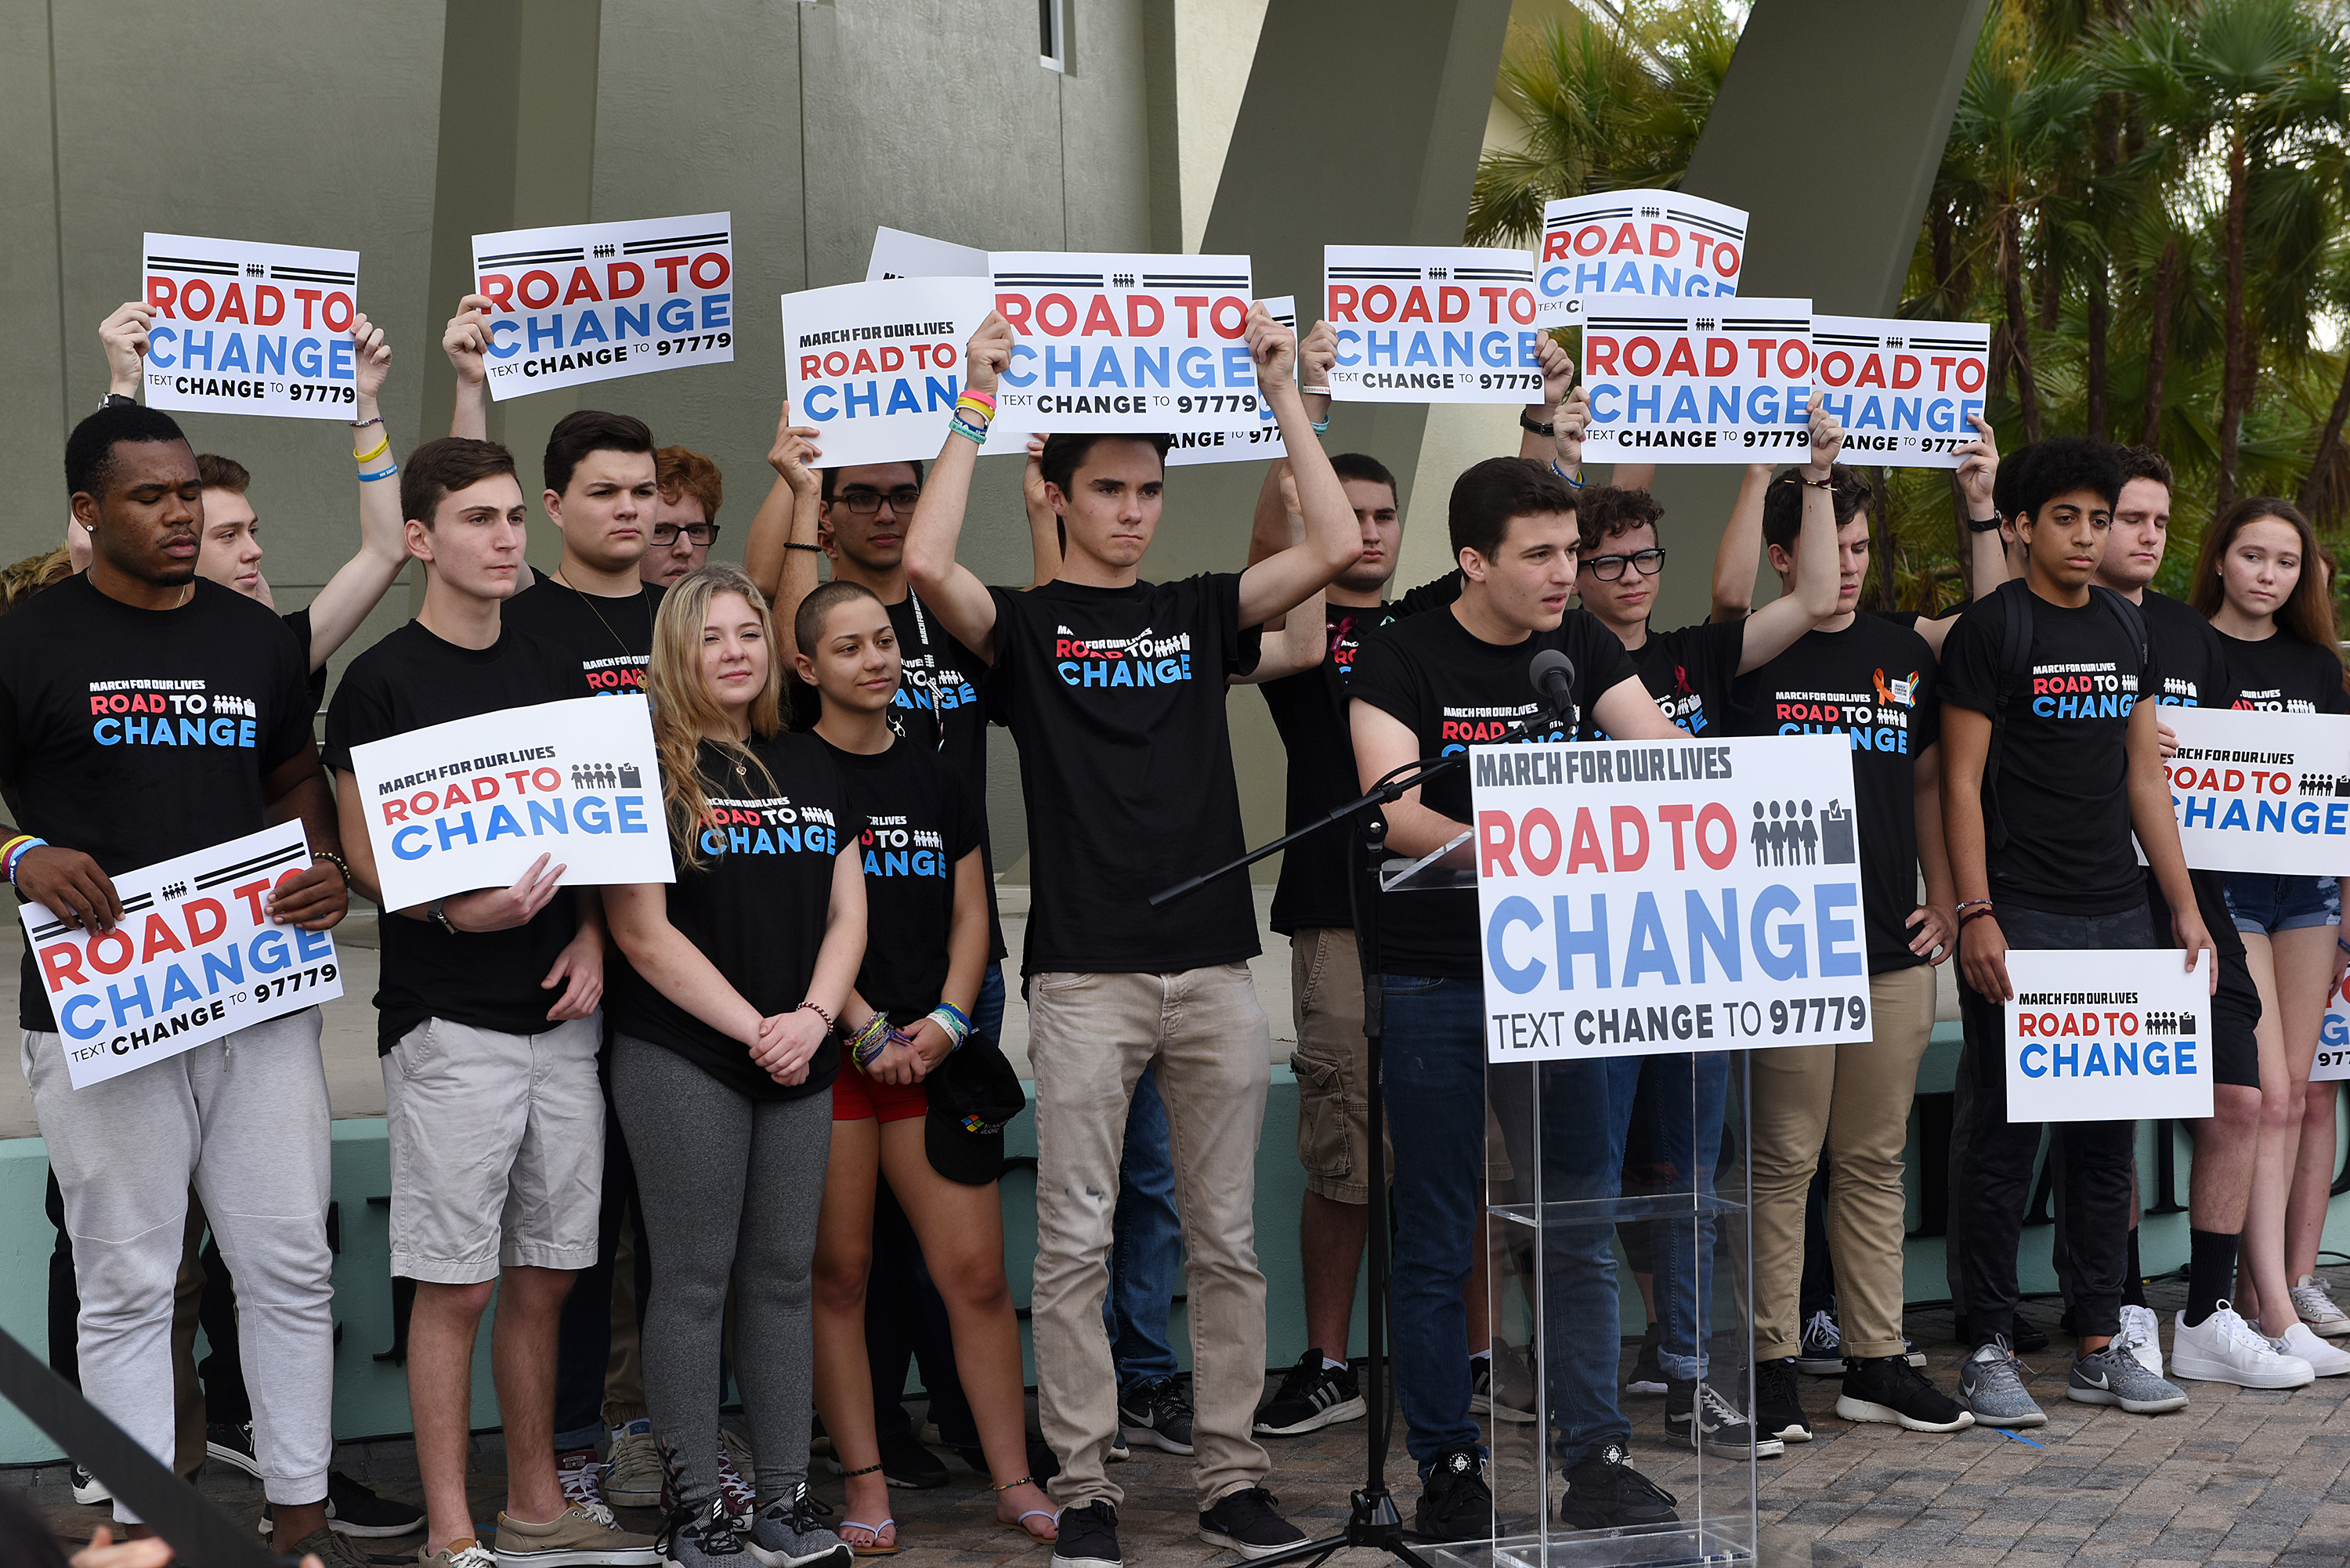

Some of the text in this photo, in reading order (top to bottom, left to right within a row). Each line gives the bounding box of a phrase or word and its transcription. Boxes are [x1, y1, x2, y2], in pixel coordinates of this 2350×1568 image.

[1542, 222, 1740, 277] ROAD TO
[479, 252, 730, 315] ROAD TO
[147, 276, 354, 333] ROAD TO
[996, 293, 1249, 340] ROAD TO
[1329, 284, 1536, 325] ROAD TO
[1538, 301, 1563, 312] TEXT
[486, 293, 730, 359] CHANGE
[800, 321, 954, 348] MARCH FOR OUR LIVES
[147, 327, 354, 380] CHANGE
[490, 332, 731, 378] TEXT CHANGE TO 97779
[801, 342, 957, 381] ROAD TO
[1335, 330, 1541, 367] CHANGE
[1586, 336, 1810, 379] ROAD TO
[1002, 344, 1255, 388] CHANGE
[1332, 372, 1542, 389] TEXT CHANGE TO 97779
[1930, 356, 1986, 393] TO
[148, 374, 356, 403] TEXT CHANGE TO 97779
[804, 374, 971, 421] CHAN
[1002, 395, 1033, 406] TEXT
[1037, 395, 1147, 414] CHANGE
[1153, 396, 1170, 406] TO
[1177, 395, 1256, 414] 97779
[1589, 383, 1810, 425] CHANGE
[1823, 393, 1983, 433] HANGE
[1170, 426, 1282, 449] ANGE 977
[1586, 430, 1810, 448] TEXT CHANGE TO 97779
[1842, 435, 1978, 453] ANGE TO 977
[1057, 638, 1153, 659] ROAD TO
[1086, 627, 1153, 649] FOR OUR LIVES
[583, 658, 613, 670] MARCH
[614, 656, 632, 665] FOR
[902, 669, 927, 686] TO
[1058, 654, 1192, 687] CHANGE
[2033, 662, 2116, 674] MARCH FOR OUR LIVES
[89, 679, 206, 692] MARCH FOR OUR LIVES
[895, 682, 977, 710] ANGE
[1776, 692, 1871, 703] MARCH FOR OUR LIVES
[2034, 675, 2119, 695] ROAD TO
[2242, 688, 2281, 699] OUR LIVES
[90, 693, 207, 715] ROAD TO
[1444, 703, 1538, 717] MARCH FOR OUR LIVES
[1776, 703, 1872, 724] ROAD TO
[2254, 701, 2283, 713] TO
[93, 717, 257, 748] CHANGE
[1442, 721, 1506, 741] ROAD
[378, 746, 556, 795] MARCH FOR OUR LIVES
[1477, 746, 1732, 787] MARCH FOR OUR LIVES
[2162, 748, 2294, 764] RCH FOR OUR LIVES
[381, 767, 561, 826] ROAD TO
[2251, 771, 2291, 795] TO
[724, 799, 743, 807] FOR
[762, 797, 790, 807] LIVES
[761, 807, 797, 826] TO
[392, 795, 649, 860] CHANGE
[879, 815, 907, 826] LIVES
[700, 825, 836, 855] CHANGE
[875, 829, 909, 848] TO
[1478, 802, 1737, 878] ROAD TO
[864, 850, 945, 879] ANGE
[38, 868, 306, 993] ROAD T
[1487, 883, 1862, 995] CHANGE
[61, 919, 332, 1040] CHANGE
[71, 963, 337, 1063] TEXT CHANGE TO 97779
[2019, 992, 2138, 1005] MARCH FOR OUR LIVES
[1492, 995, 1866, 1050] TEXT CHANGE TO 97779
[2019, 1012, 2138, 1037] ROAD TO
[2019, 1041, 2197, 1078] CHANGE
